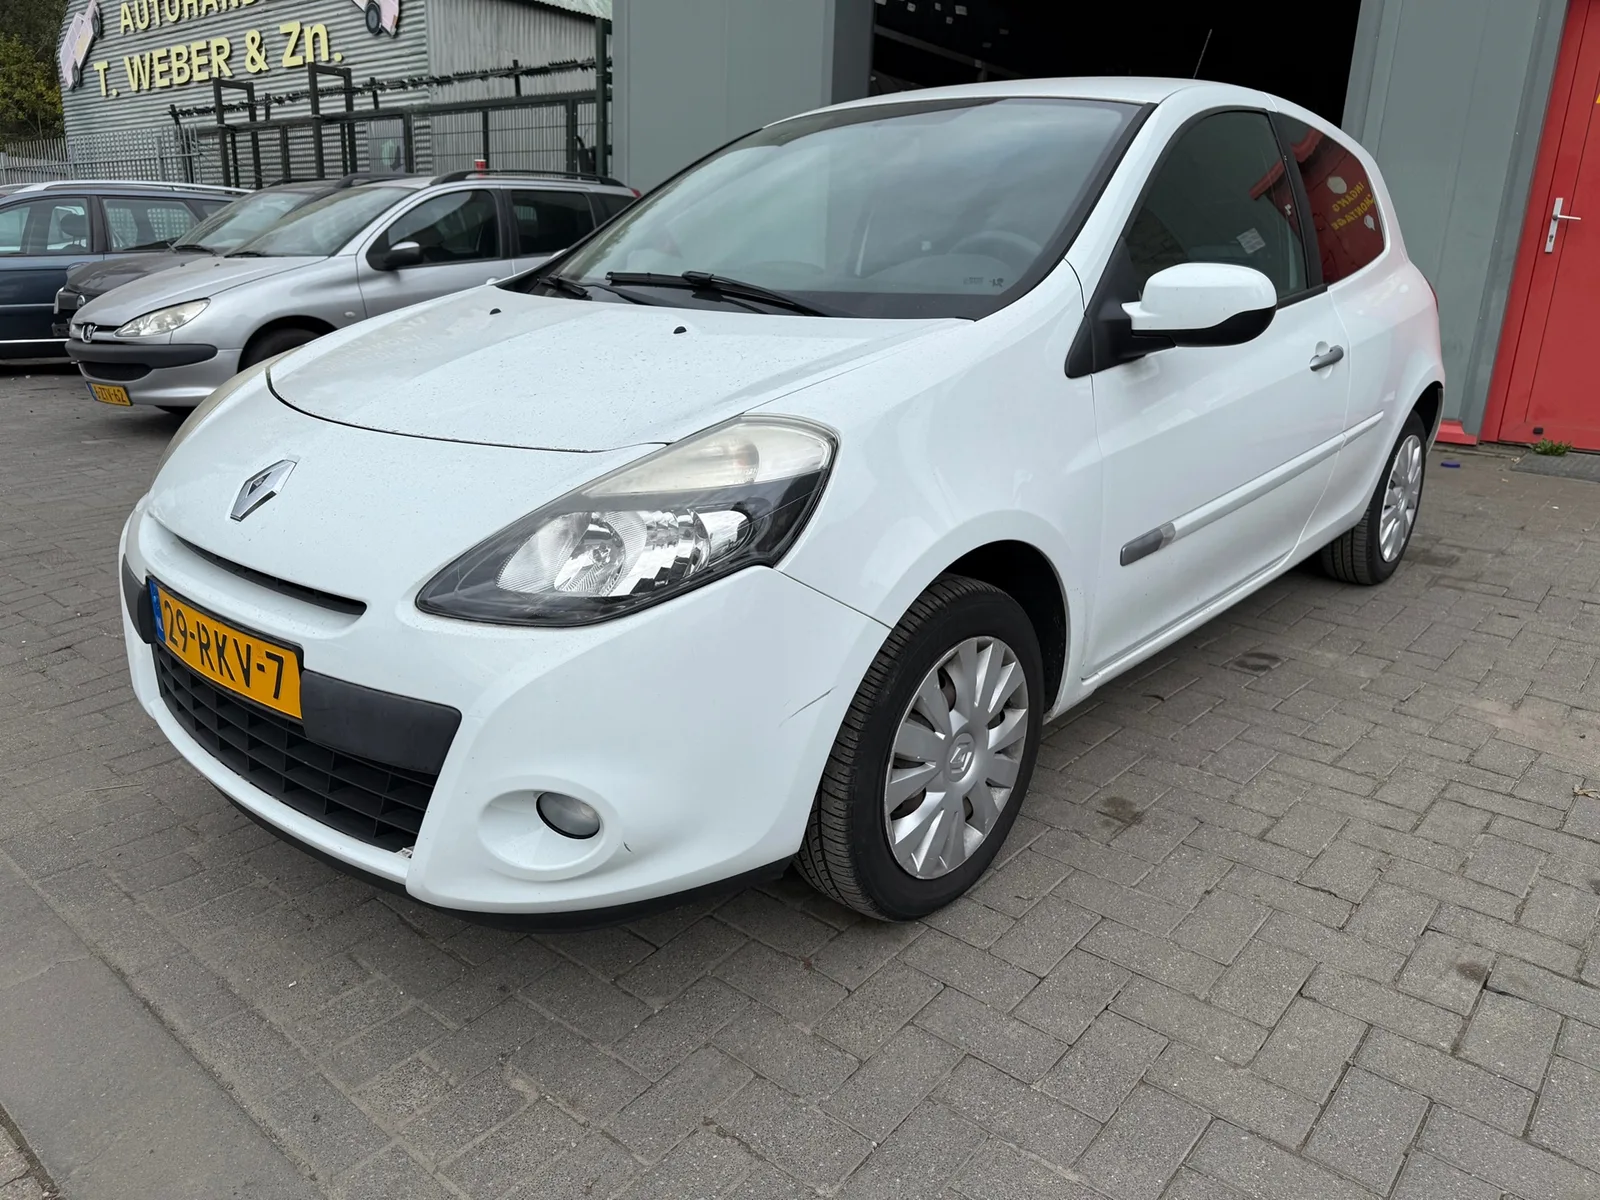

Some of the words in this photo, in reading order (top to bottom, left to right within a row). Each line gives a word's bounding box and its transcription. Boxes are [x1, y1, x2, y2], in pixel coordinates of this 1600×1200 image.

[93, 61, 119, 97] T.
[123, 37, 232, 92] WEBER
[245, 29, 270, 73] &
[279, 21, 343, 68] Zn.
[164, 600, 284, 700] 29-RKV-7
